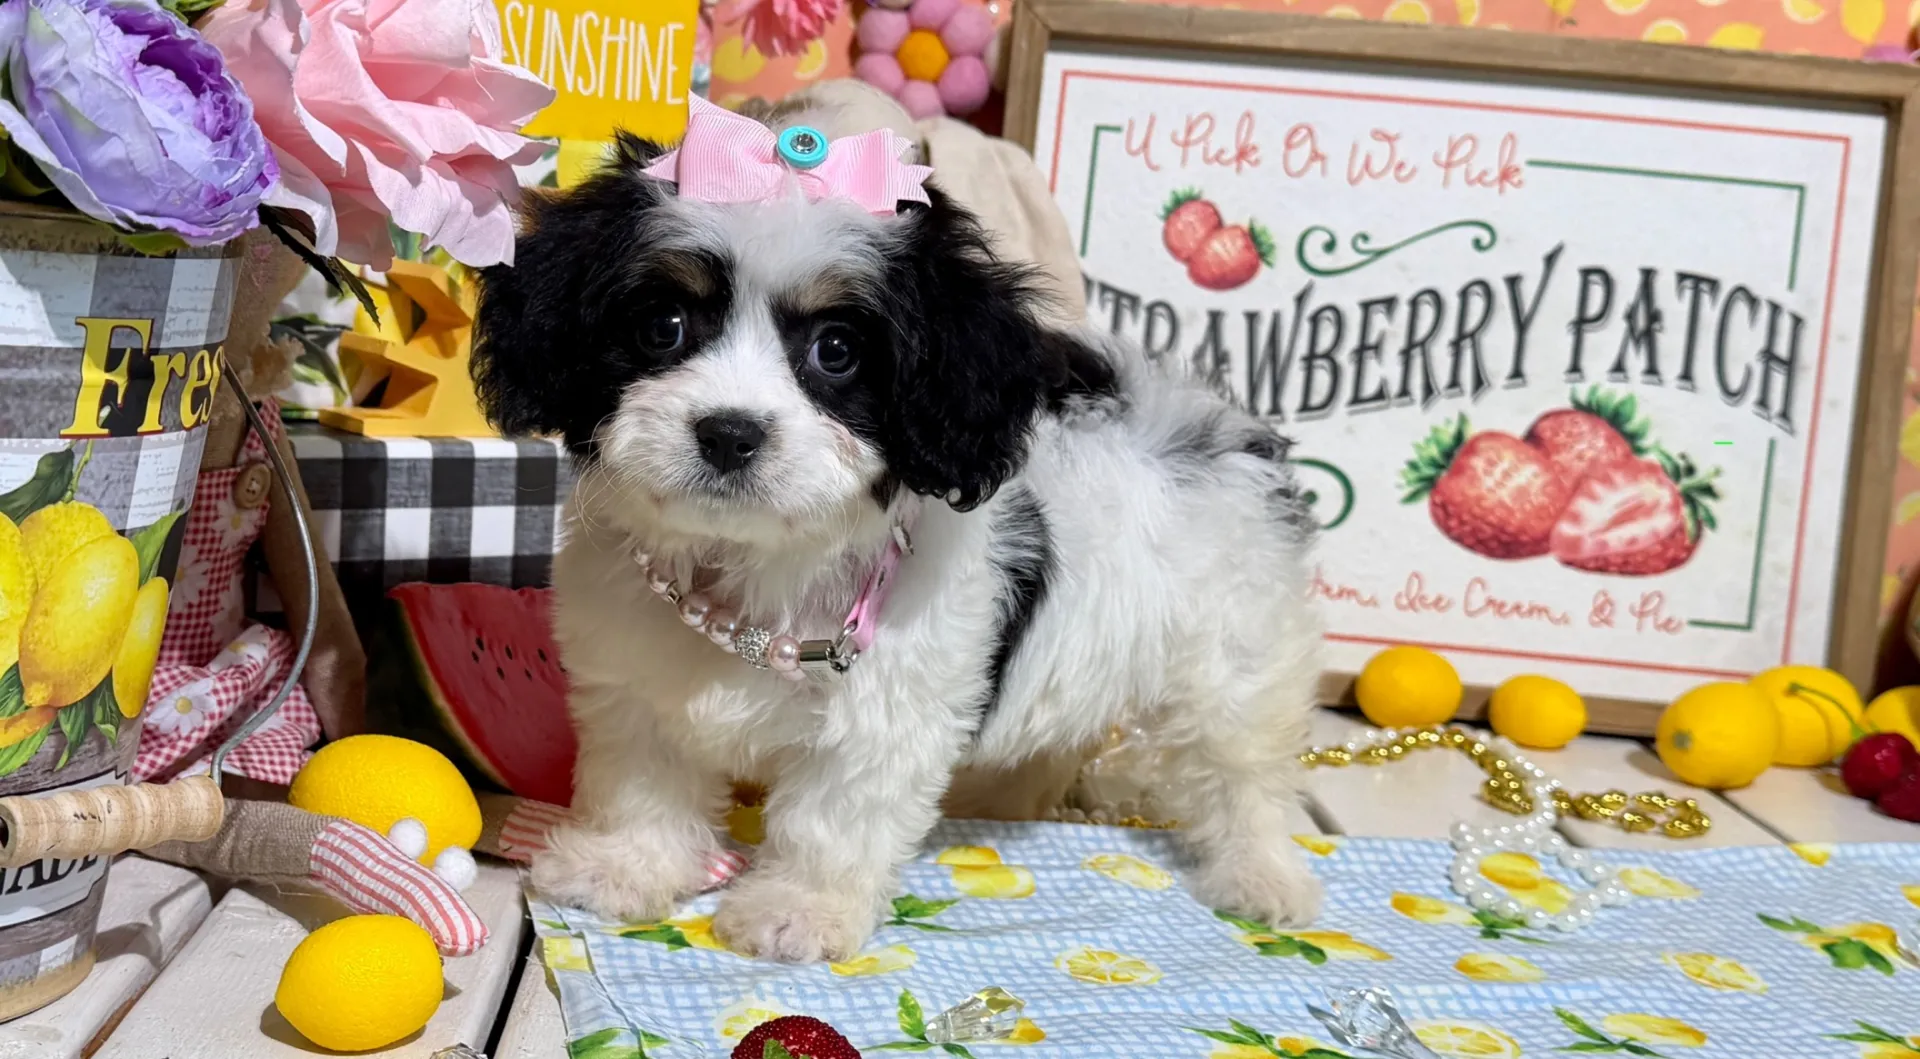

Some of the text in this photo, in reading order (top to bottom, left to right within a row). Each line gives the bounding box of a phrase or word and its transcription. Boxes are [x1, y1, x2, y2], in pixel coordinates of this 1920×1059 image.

[503, 2, 685, 105] SUNSHINE
[1124, 108, 1524, 196] U Pick Or We Pick
[1083, 241, 1806, 438] TRAWBERRY PATCH
[1393, 570, 1454, 614] Ice
[1587, 588, 1617, 629] &
[1628, 589, 1685, 635] Pie
